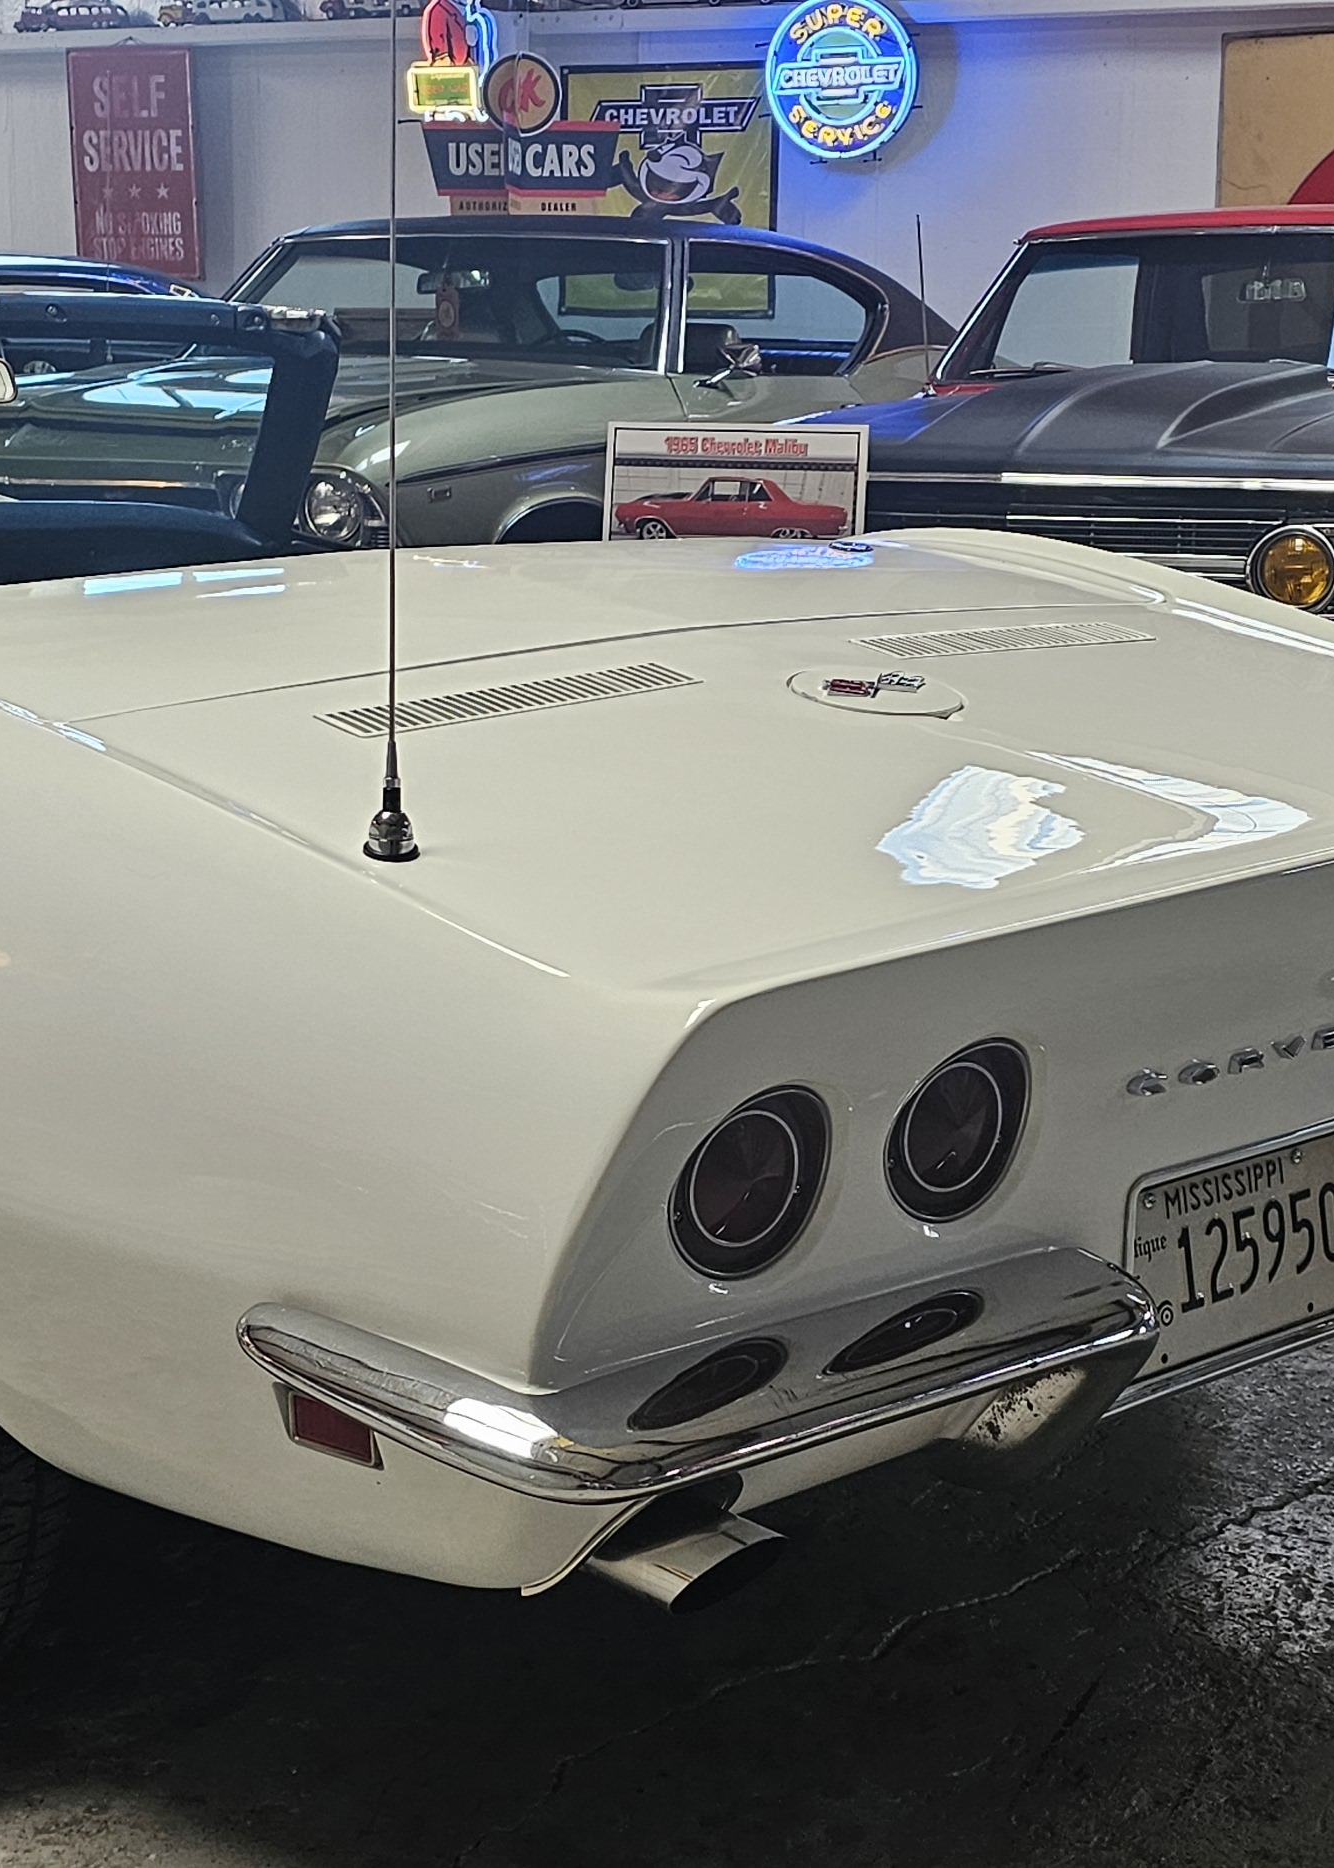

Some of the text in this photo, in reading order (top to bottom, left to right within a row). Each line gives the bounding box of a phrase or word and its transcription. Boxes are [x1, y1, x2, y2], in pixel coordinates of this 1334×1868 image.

[790, 4, 887, 44] SUPER
[780, 64, 899, 88] CHEVROLET
[93, 74, 165, 118] SELF
[604, 106, 739, 125] CHEVROLET
[789, 101, 893, 146] SERVICE
[83, 129, 184, 172] SERVICE
[525, 143, 596, 177] CARS
[541, 202, 577, 212] DEALER
[700, 436, 762, 456] Chevrolet
[764, 438, 809, 456] Malibu
[1164, 1156, 1285, 1220] MISSISSIPPI
[1133, 1234, 1167, 1263] tique
